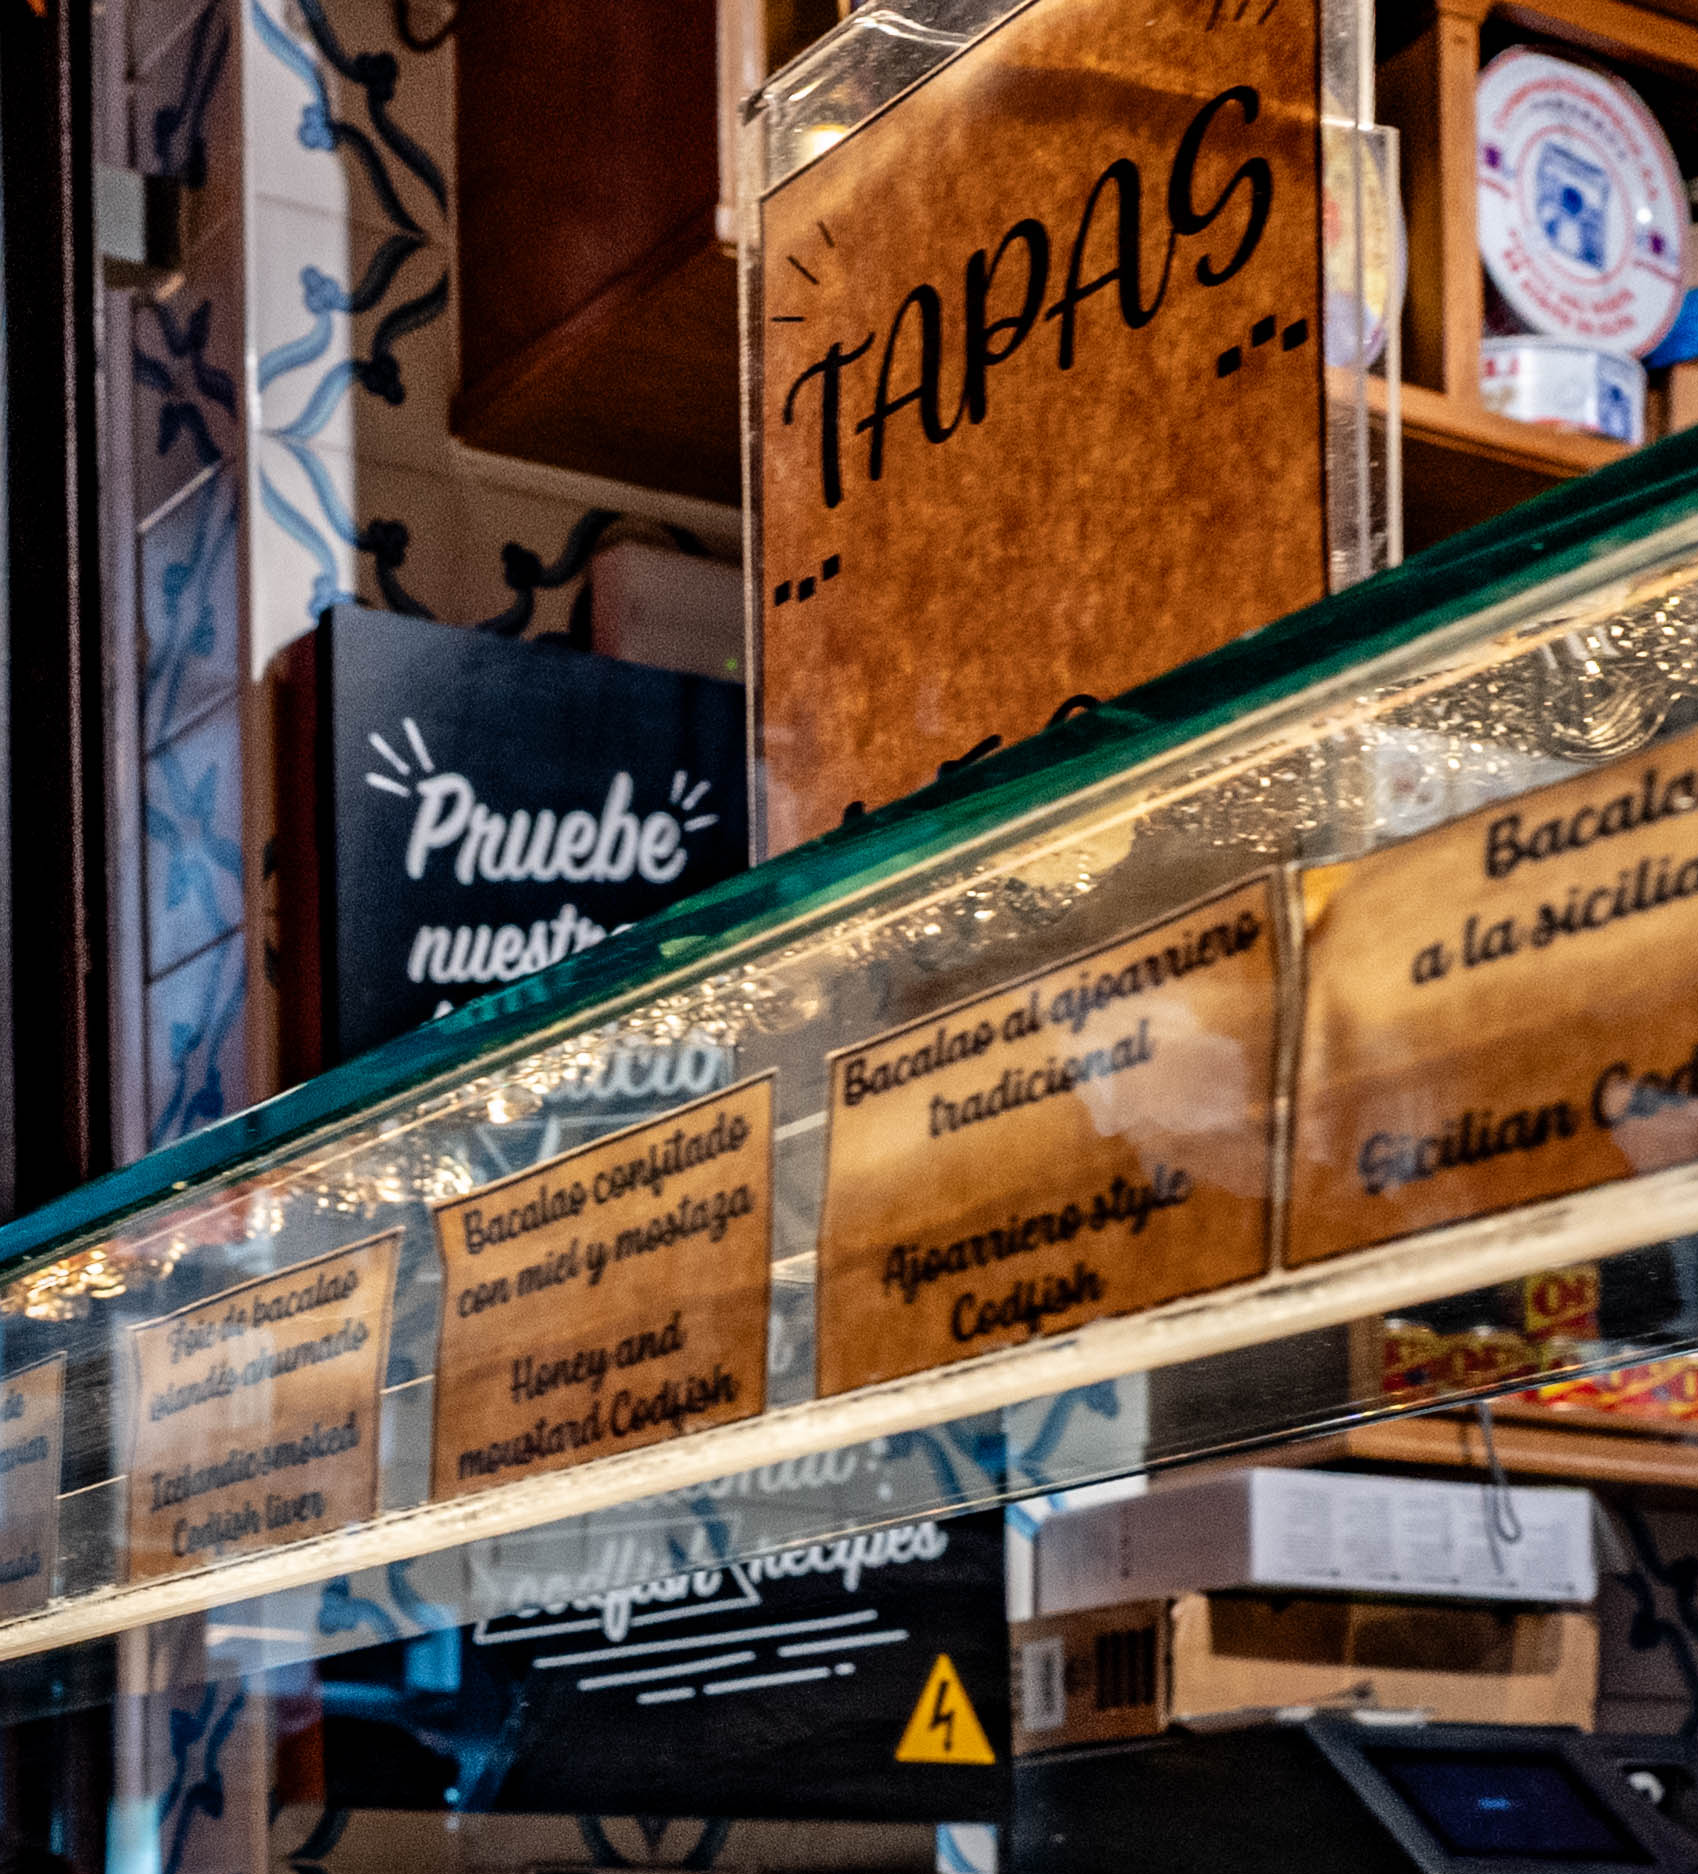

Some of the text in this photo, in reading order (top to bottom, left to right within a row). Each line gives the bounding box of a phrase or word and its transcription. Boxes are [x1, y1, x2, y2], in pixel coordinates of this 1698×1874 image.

[783, 85, 1273, 509] TAPAS
[405, 771, 688, 886] Pruebe
[407, 903, 637, 985] nuestr
[1409, 943, 1449, 986] a
[1462, 914, 1520, 971] la
[843, 910, 1262, 1106] Bacalao al ajoarriero
[928, 1019, 1154, 1138] tradicional
[461, 1111, 751, 1255] Bacalao confitado
[1356, 1097, 1577, 1197] Sicilian
[457, 1181, 755, 1319] con miel y mostaza
[882, 1164, 1192, 1303] Ajoarriero style
[251, 1269, 361, 1328] bacalao
[952, 1261, 1107, 1343] Codfish
[510, 1309, 687, 1403] Honey and
[608, 1362, 741, 1438] Codfish
[257, 1411, 361, 1477] smoked
[172, 1491, 326, 1556] Codfish liver
